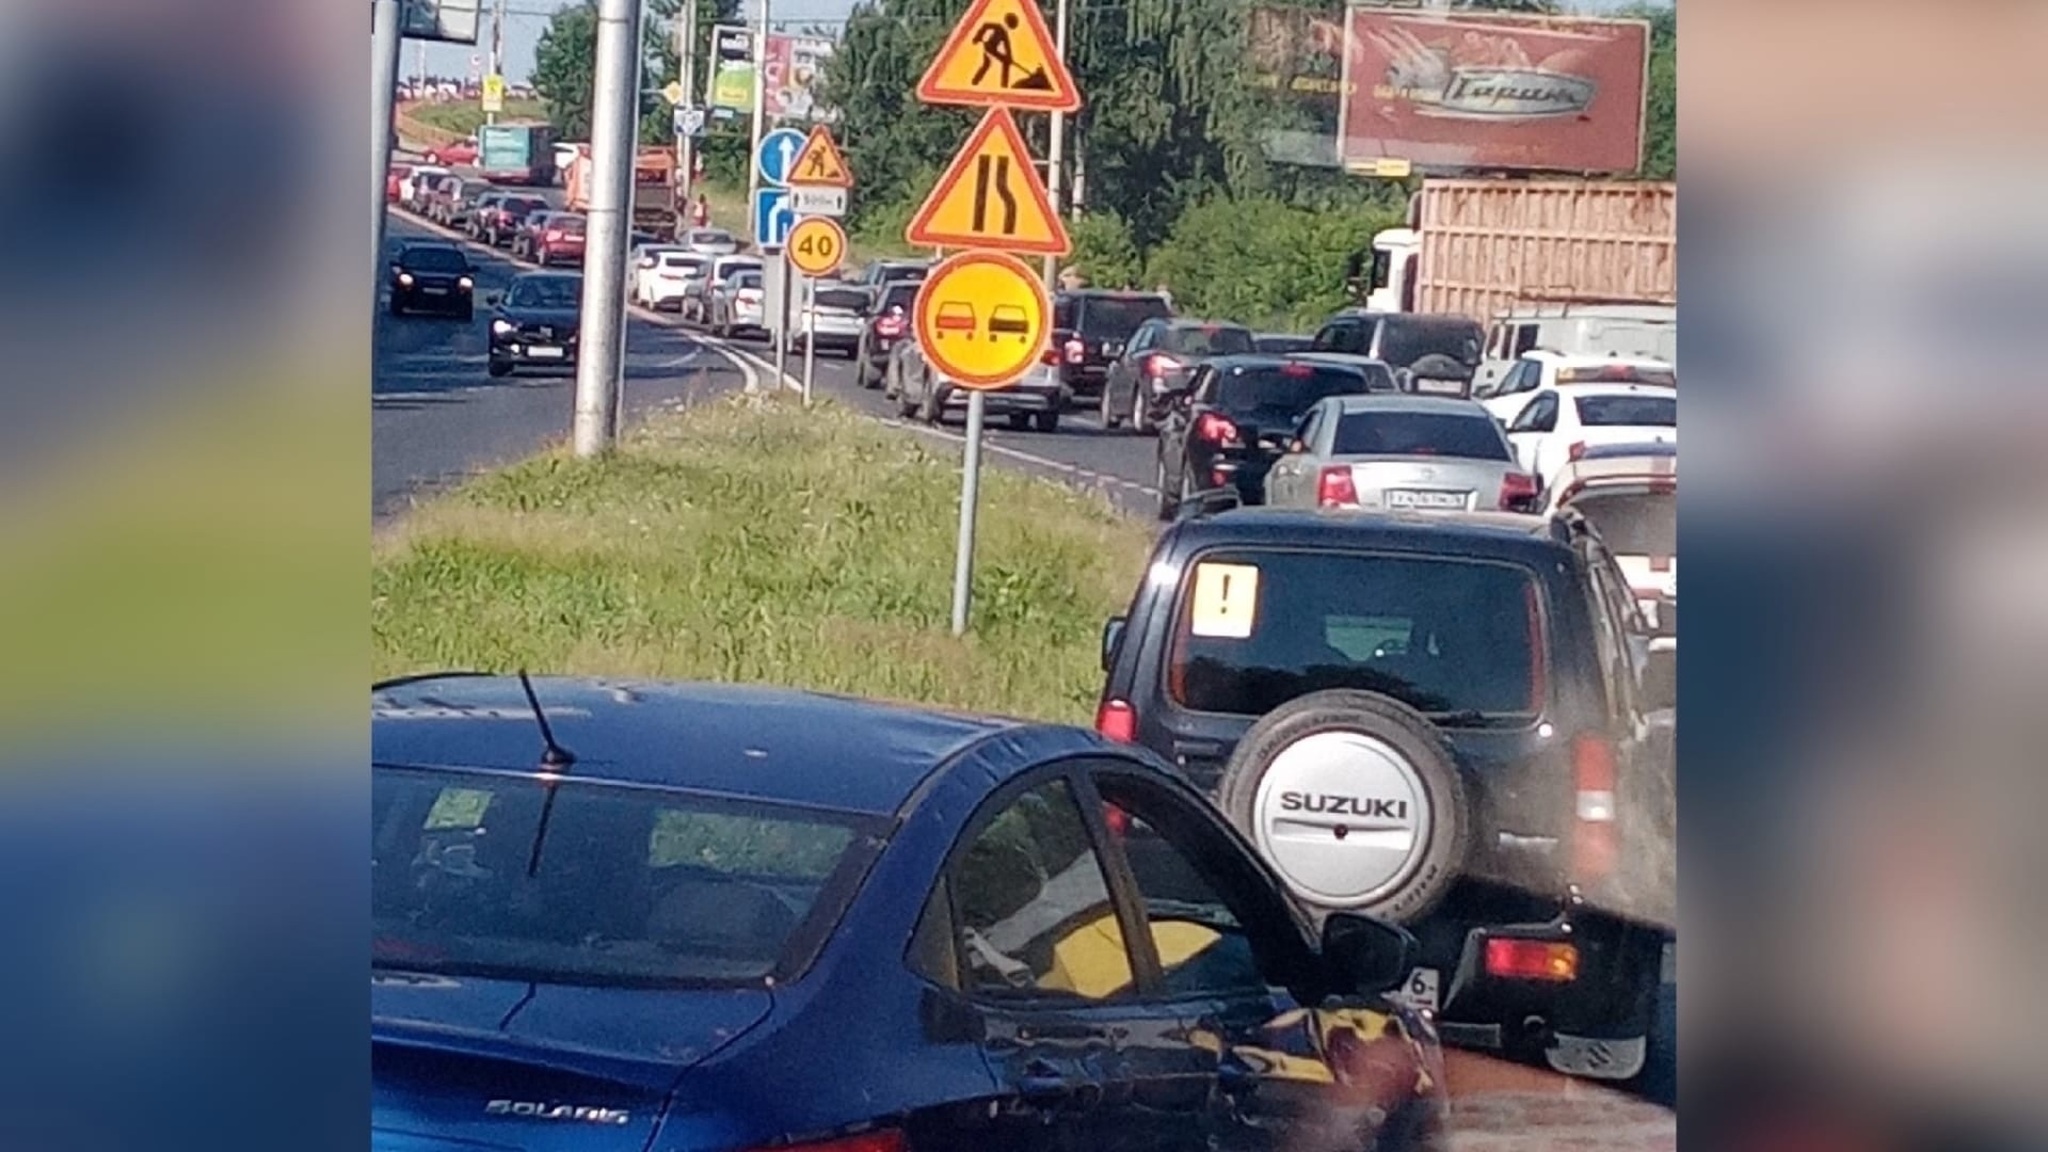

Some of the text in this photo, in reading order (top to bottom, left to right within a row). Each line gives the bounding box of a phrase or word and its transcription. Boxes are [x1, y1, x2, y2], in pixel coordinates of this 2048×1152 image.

[798, 234, 833, 257] 40
[1280, 791, 1407, 819] SUZUKI
[485, 1099, 630, 1125] SOLARIS
